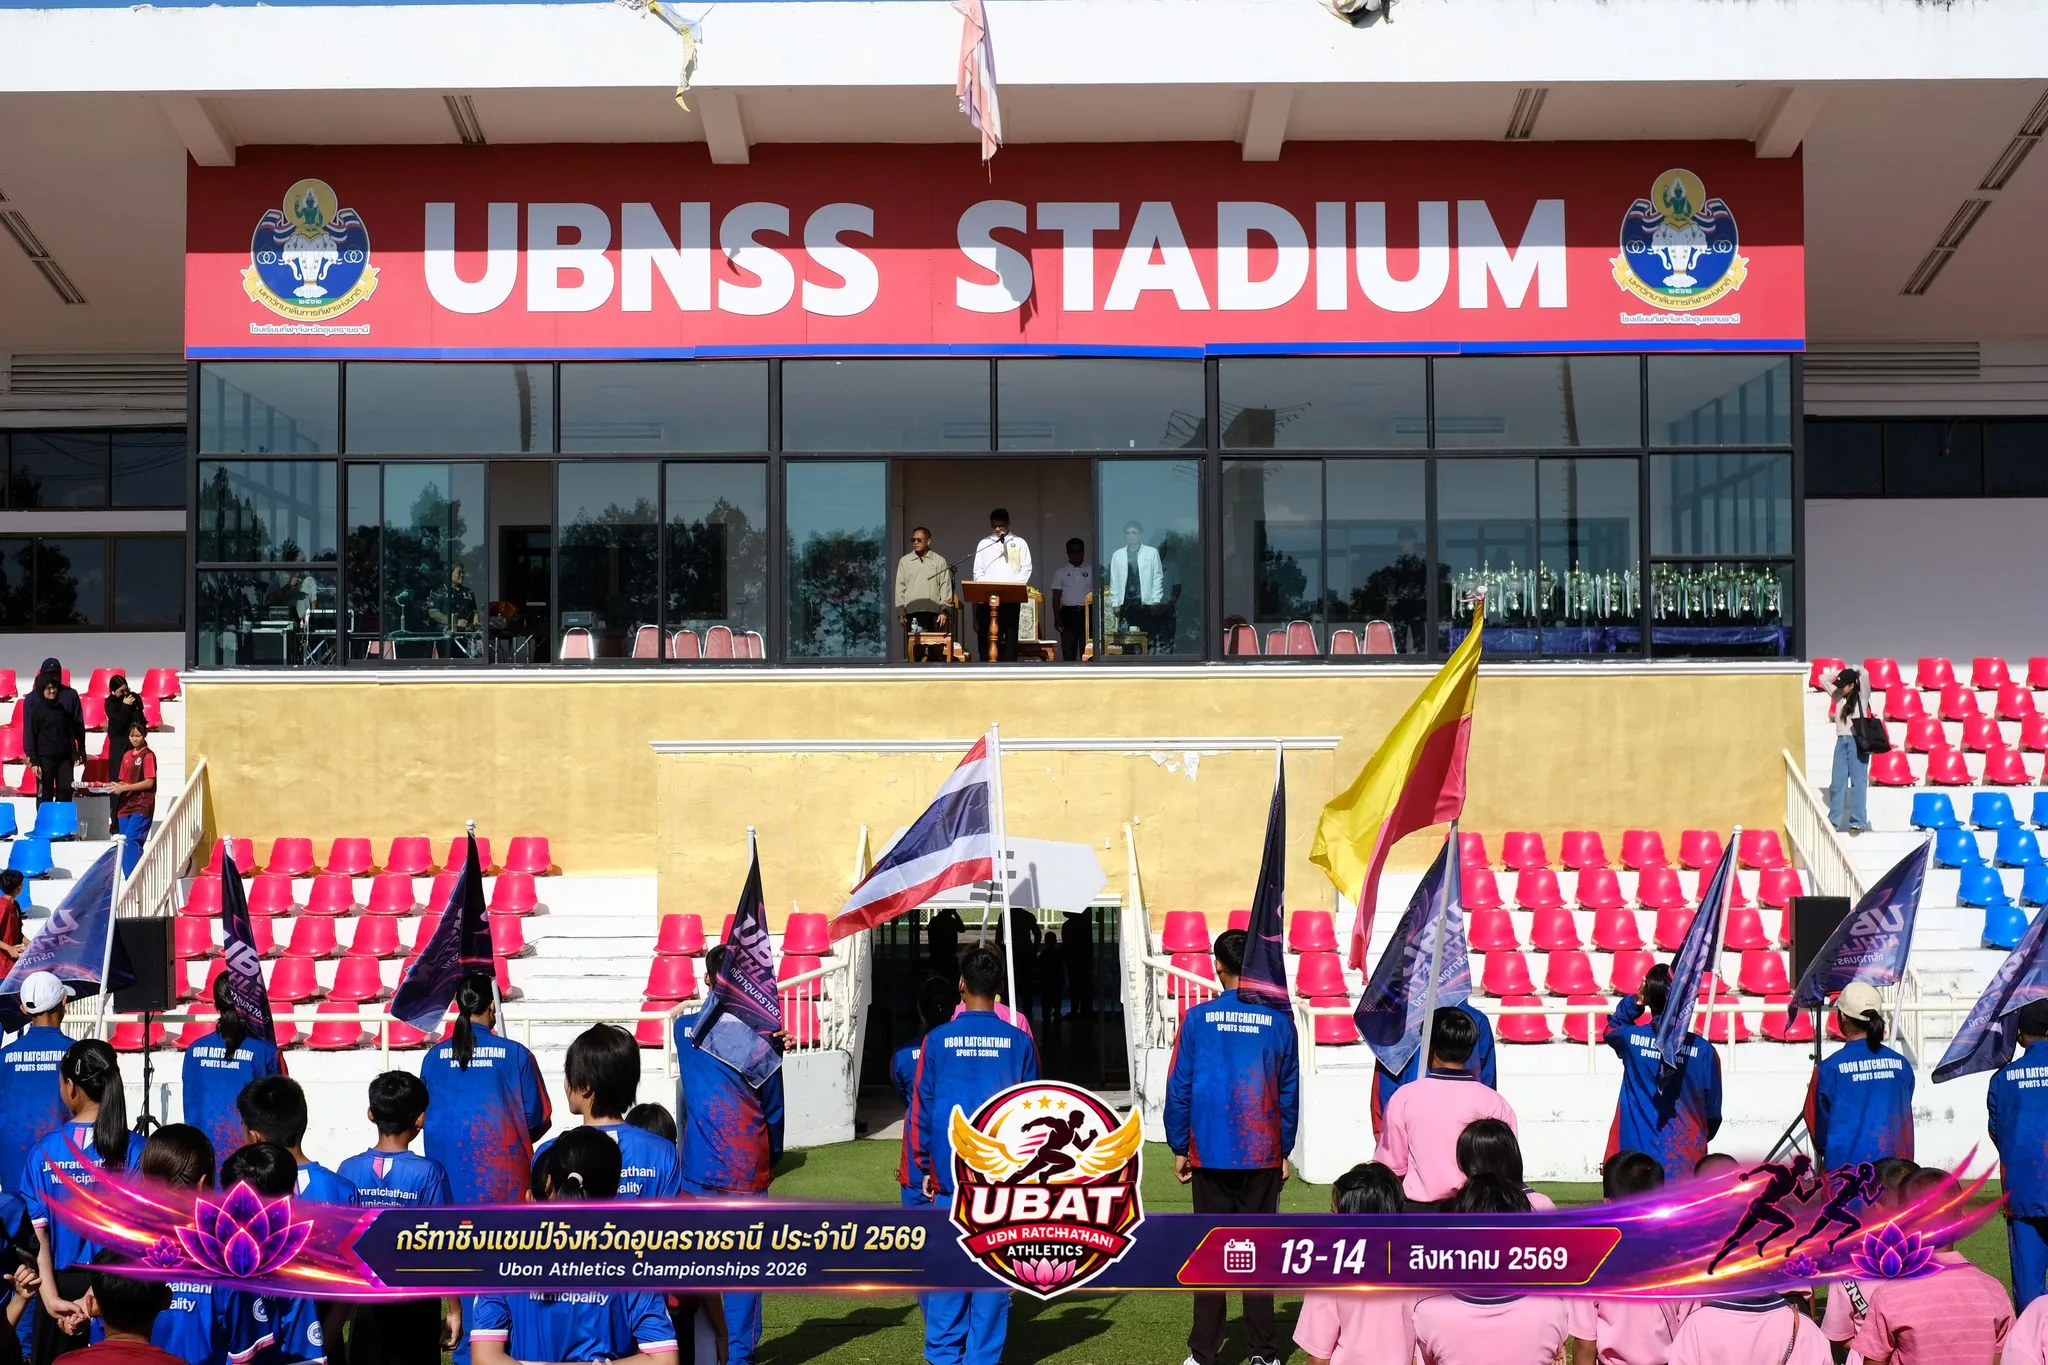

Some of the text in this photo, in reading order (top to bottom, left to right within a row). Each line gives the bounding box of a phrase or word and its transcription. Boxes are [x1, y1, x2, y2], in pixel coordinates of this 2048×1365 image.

[423, 199, 1568, 317] UBNSS STADIUM
[1205, 1011, 1272, 1026] UBON RATCHATHANI
[1217, 1023, 1260, 1034] SPORTS SCHOOL
[944, 1036, 1011, 1048] UBON RATCHATHANI
[1630, 1033, 1650, 1048] UBON
[209, 1047, 254, 1061] RATCTHANI
[440, 1047, 453, 1059] UBO
[956, 1049, 999, 1058] SPORTS SCHOOL
[15, 1063, 57, 1071] SPORTS SCHOOL
[200, 1059, 220, 1068] SPORTS
[472, 1059, 493, 1068] SCHOOL
[1838, 1058, 1903, 1074] UBON RATCHATHANI
[1852, 1070, 1895, 1082] SPORTS SCHOOL
[2006, 1068, 2025, 1081] UBON
[2018, 1080, 2040, 1089] SPORTS
